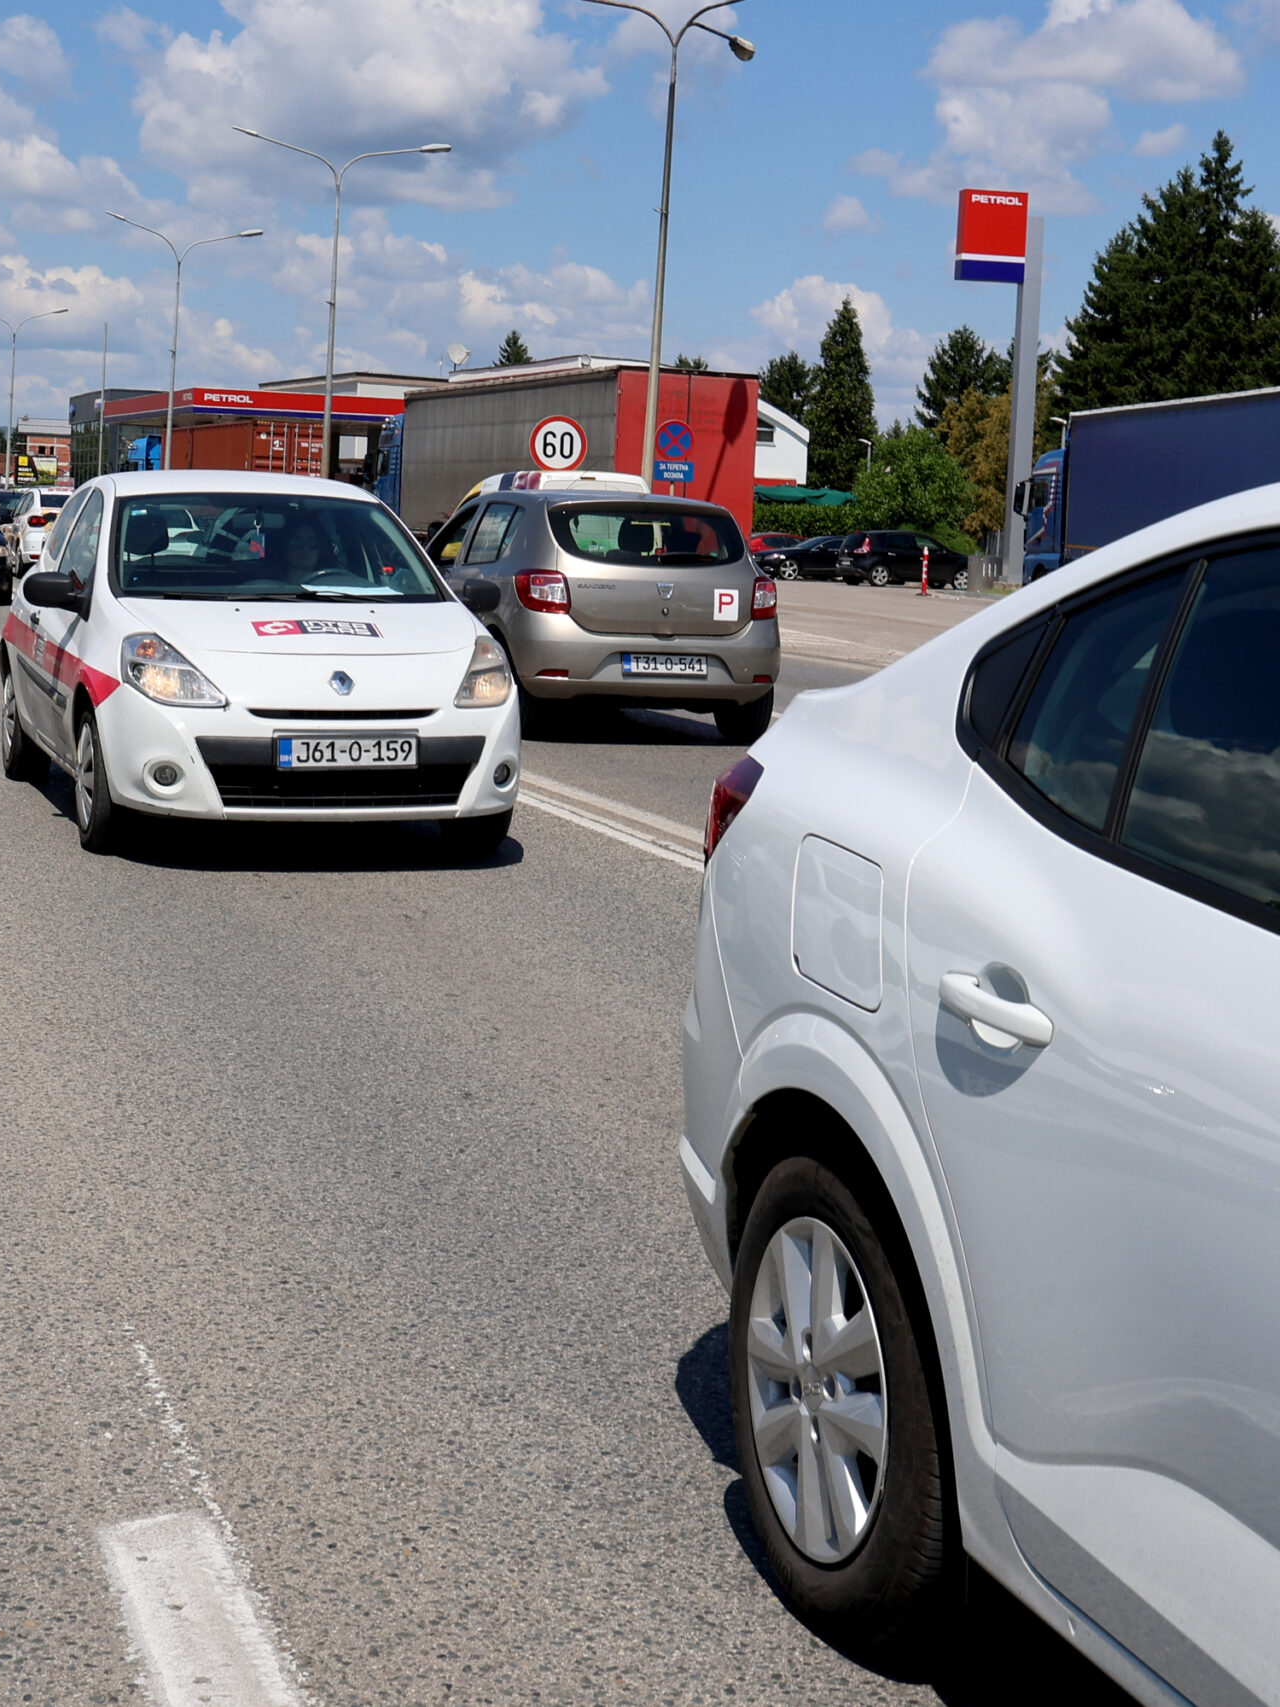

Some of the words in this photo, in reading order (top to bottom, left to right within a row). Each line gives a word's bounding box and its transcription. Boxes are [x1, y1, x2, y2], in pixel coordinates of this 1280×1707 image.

[971, 194, 1023, 206] PETROL
[203, 392, 254, 404] PETROL
[543, 431, 574, 459] 60
[668, 463, 689, 471] ТЕРЕТНА
[719, 593, 734, 613] P
[302, 620, 367, 630] INTER
[307, 627, 372, 636] CARS
